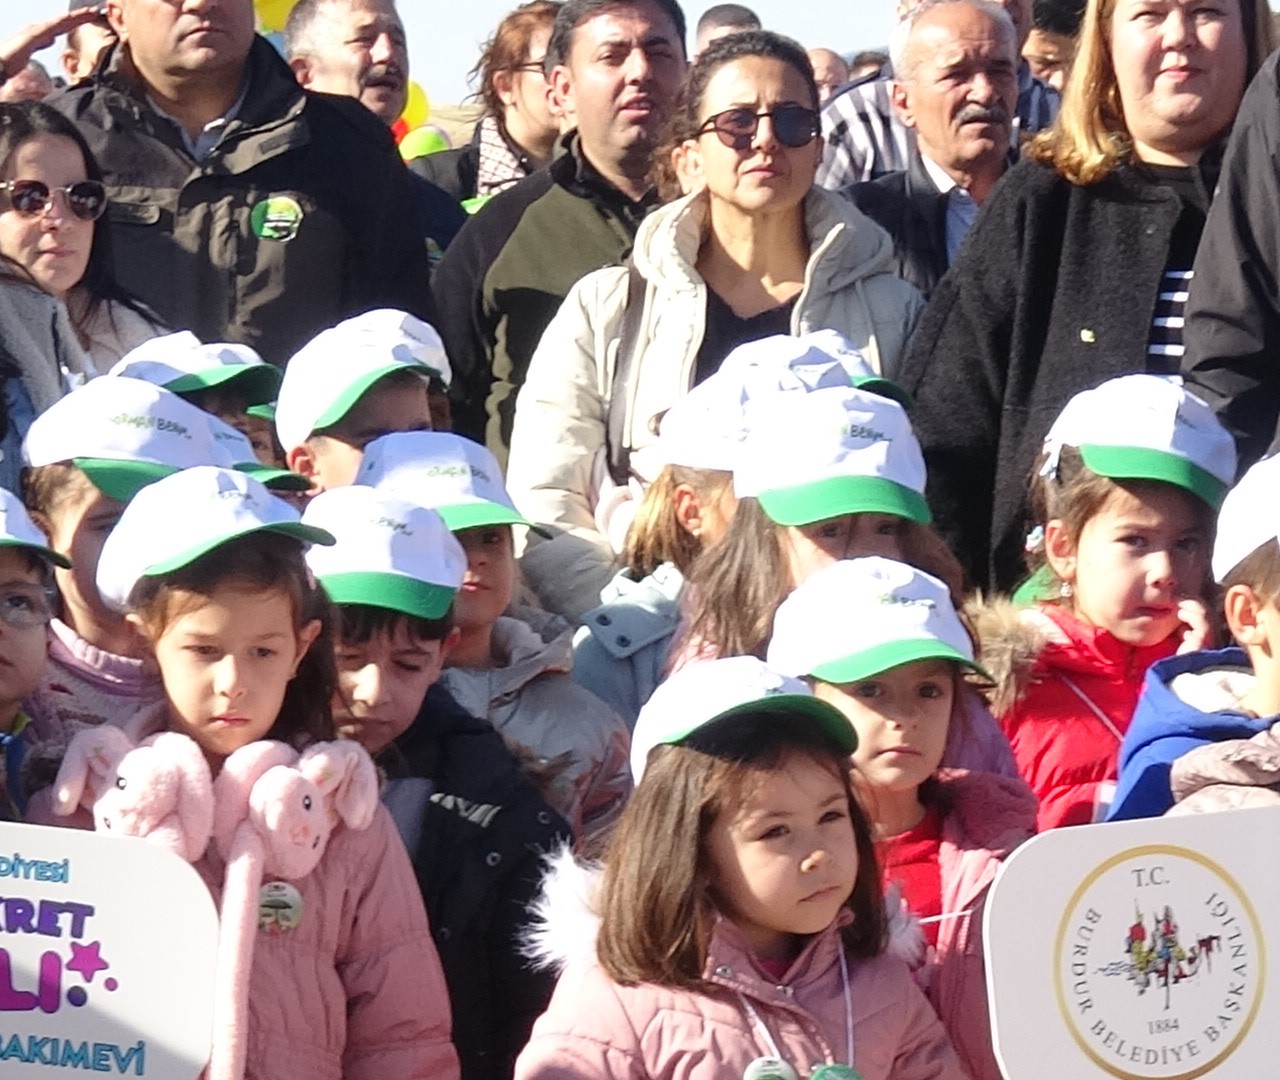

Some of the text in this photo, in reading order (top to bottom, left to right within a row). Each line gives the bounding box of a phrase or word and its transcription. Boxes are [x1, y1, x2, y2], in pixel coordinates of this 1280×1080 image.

[1132, 866, 1170, 887] T.C.
[1071, 908, 1102, 1014] BURDUR
[1090, 1019, 1201, 1064] BELEDİYE
[1147, 1018, 1179, 1035] 1884
